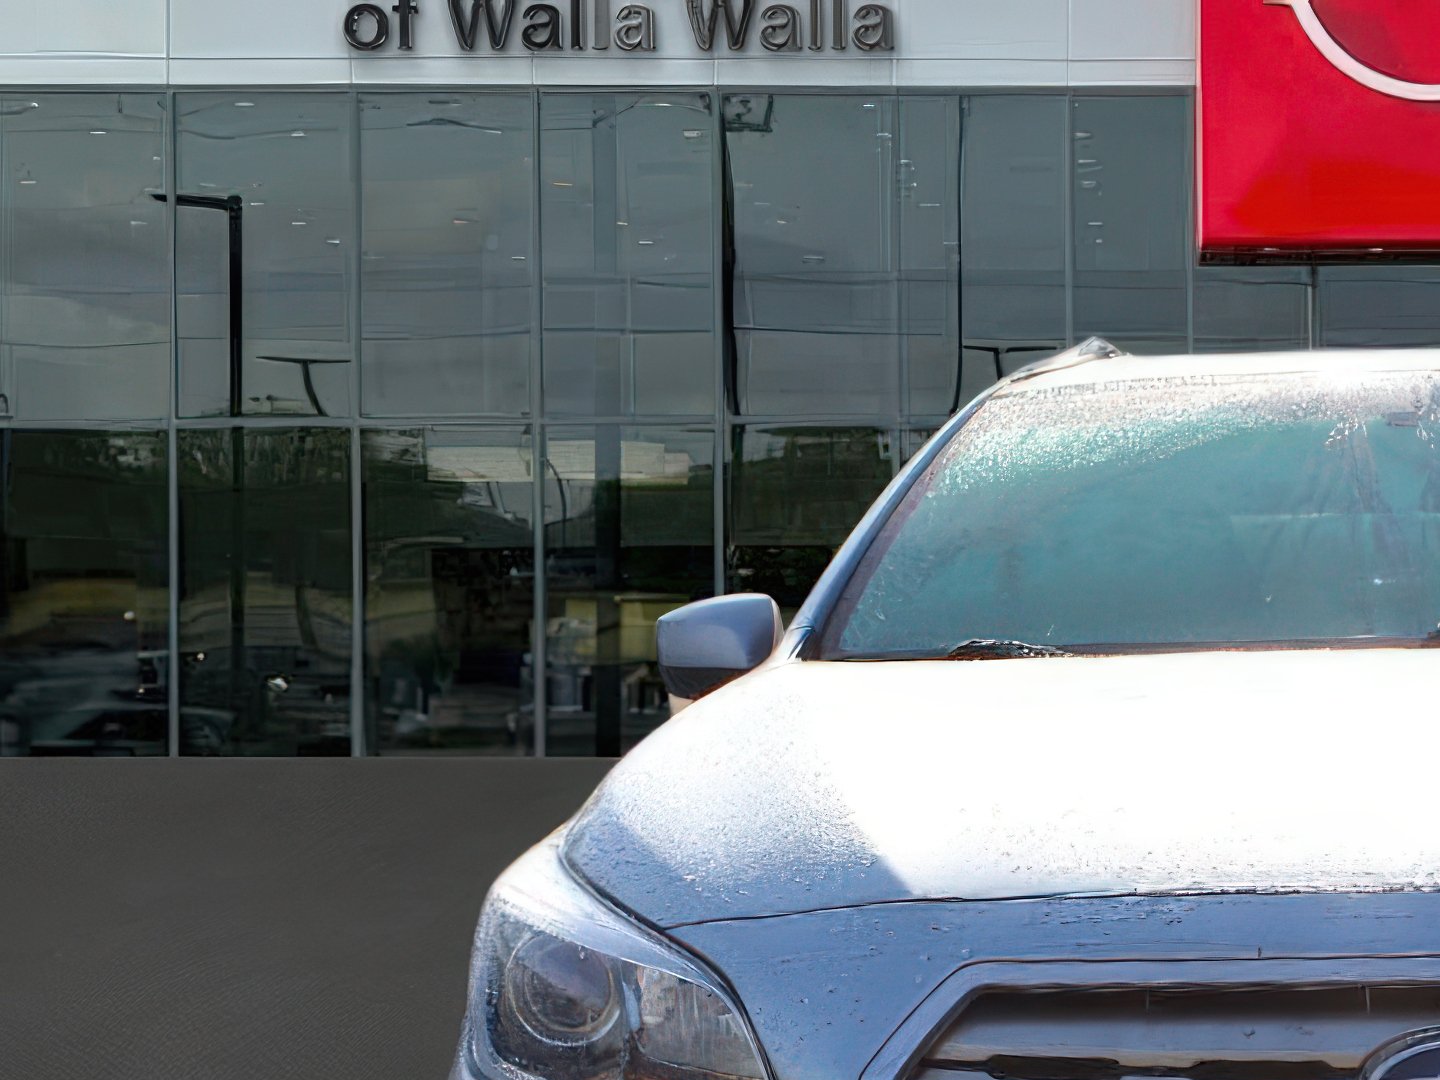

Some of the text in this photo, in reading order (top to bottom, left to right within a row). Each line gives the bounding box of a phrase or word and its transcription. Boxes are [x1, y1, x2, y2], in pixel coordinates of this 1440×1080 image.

[343, 0, 895, 50] of Walla Walla
